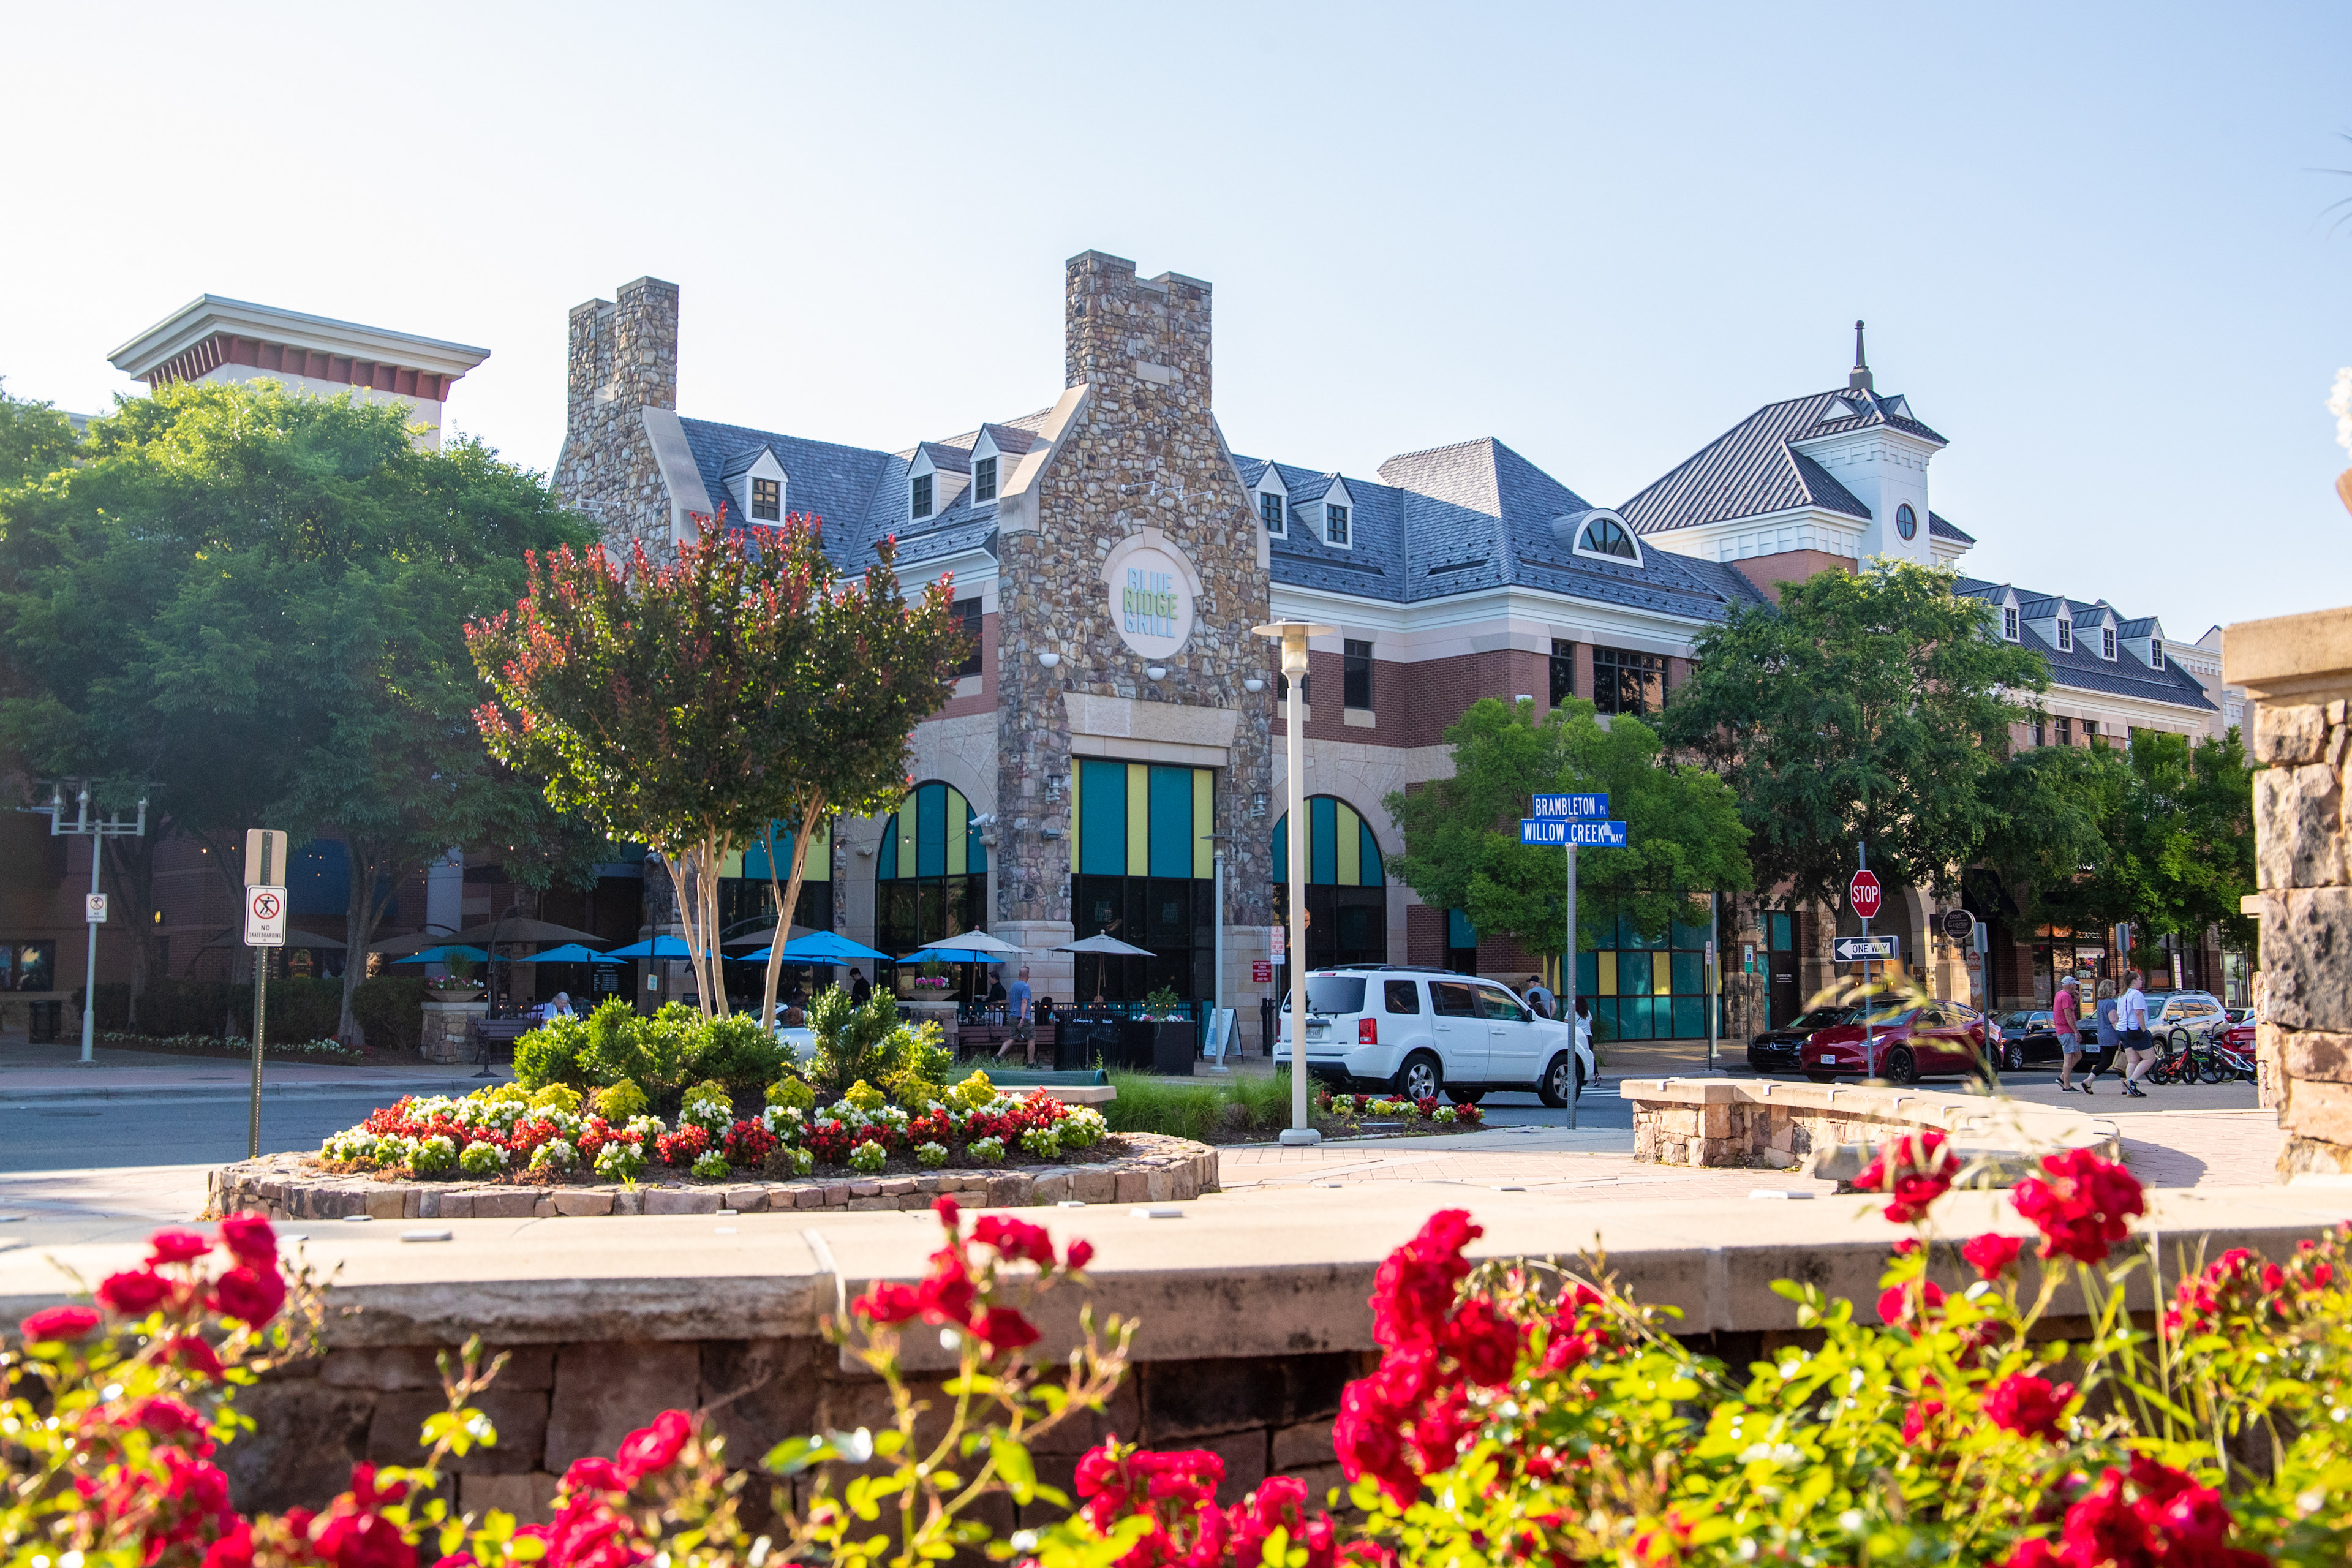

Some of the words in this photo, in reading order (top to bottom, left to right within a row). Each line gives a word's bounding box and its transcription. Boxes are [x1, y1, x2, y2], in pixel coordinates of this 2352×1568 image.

[1128, 567, 1172, 598] BLUE
[1123, 587, 1178, 619] RIDGE
[1125, 606, 1175, 638] GRILL
[1536, 797, 1596, 816] BRAMBLETON
[1600, 805, 1606, 815] PL
[1524, 823, 1564, 842] WILLOW
[1570, 824, 1605, 843] CREEK
[1610, 834, 1623, 843] WAY
[1853, 885, 1879, 903] STOP
[1852, 944, 1868, 954] ONE
[1872, 943, 1888, 954] WAY
